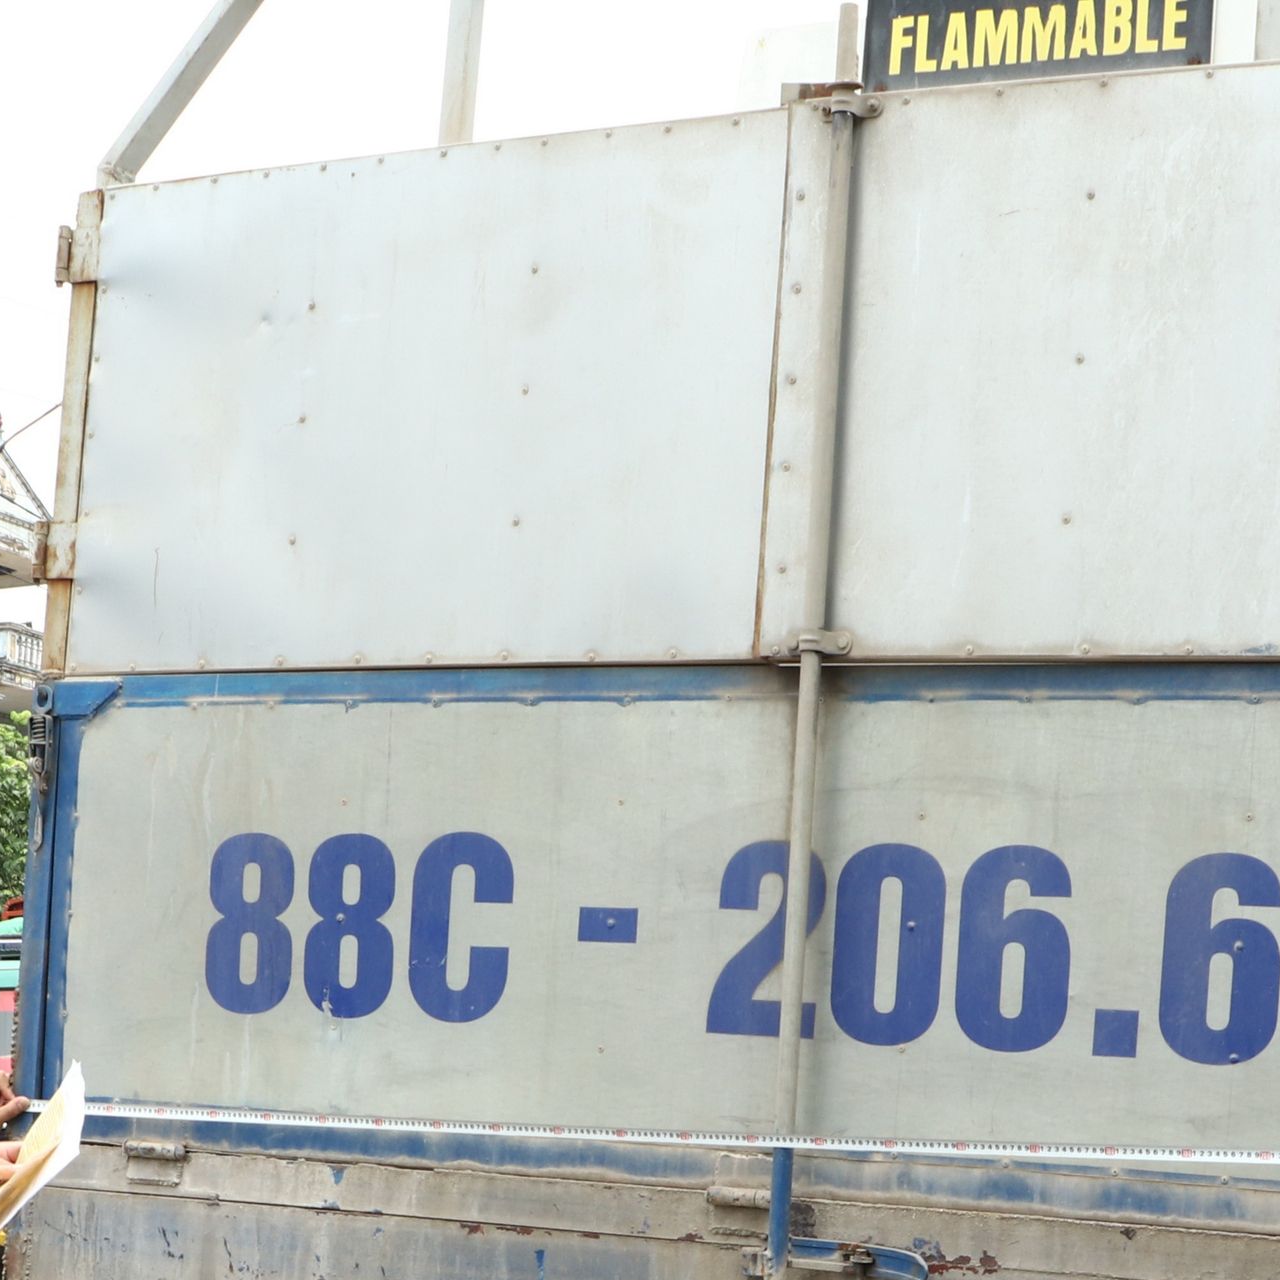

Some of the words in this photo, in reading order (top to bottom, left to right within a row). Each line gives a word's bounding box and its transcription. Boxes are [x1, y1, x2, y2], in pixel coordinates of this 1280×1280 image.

[888, 0, 1188, 75] FLAMMABLE
[206, 832, 514, 1023] 88C
[578, 906, 638, 943] -
